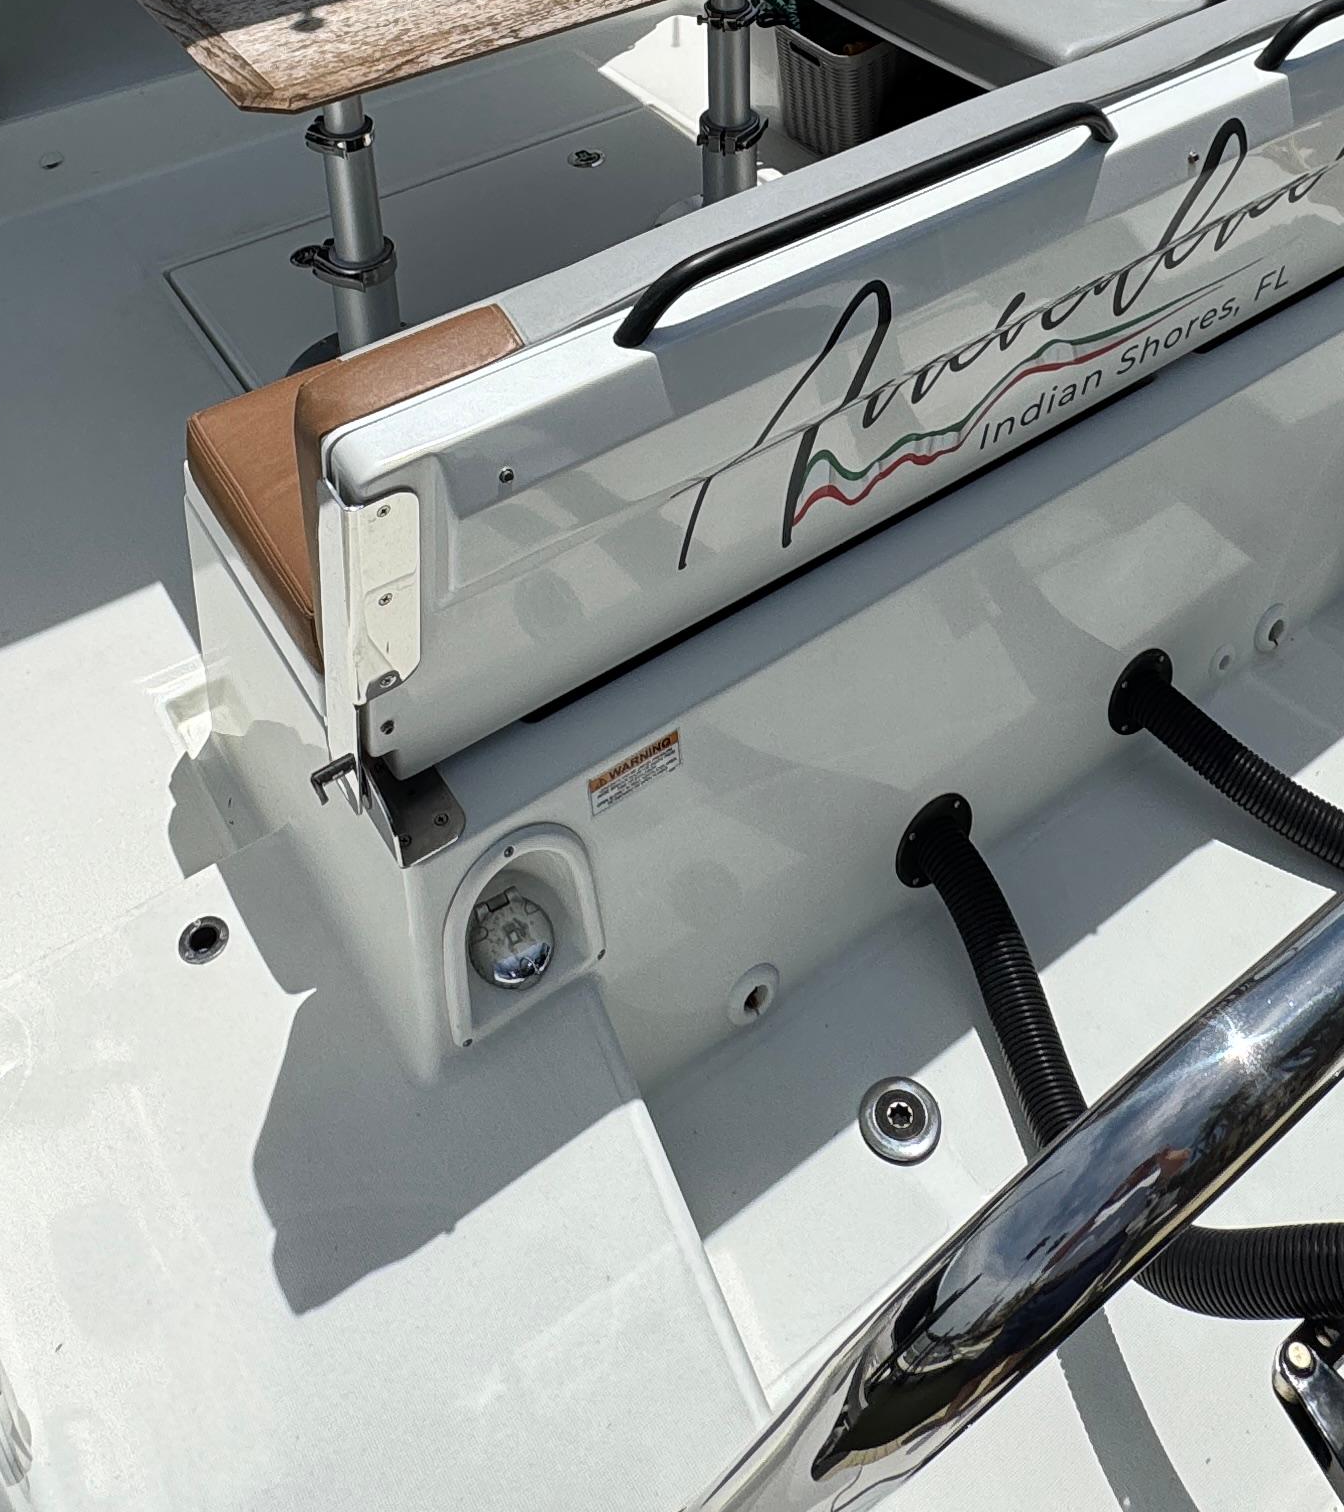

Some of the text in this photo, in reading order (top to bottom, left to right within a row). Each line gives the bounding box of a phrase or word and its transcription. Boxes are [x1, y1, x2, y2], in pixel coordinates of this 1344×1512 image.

[979, 265, 1291, 450] Indian Shores, FL
[609, 737, 671, 780] WARNING
